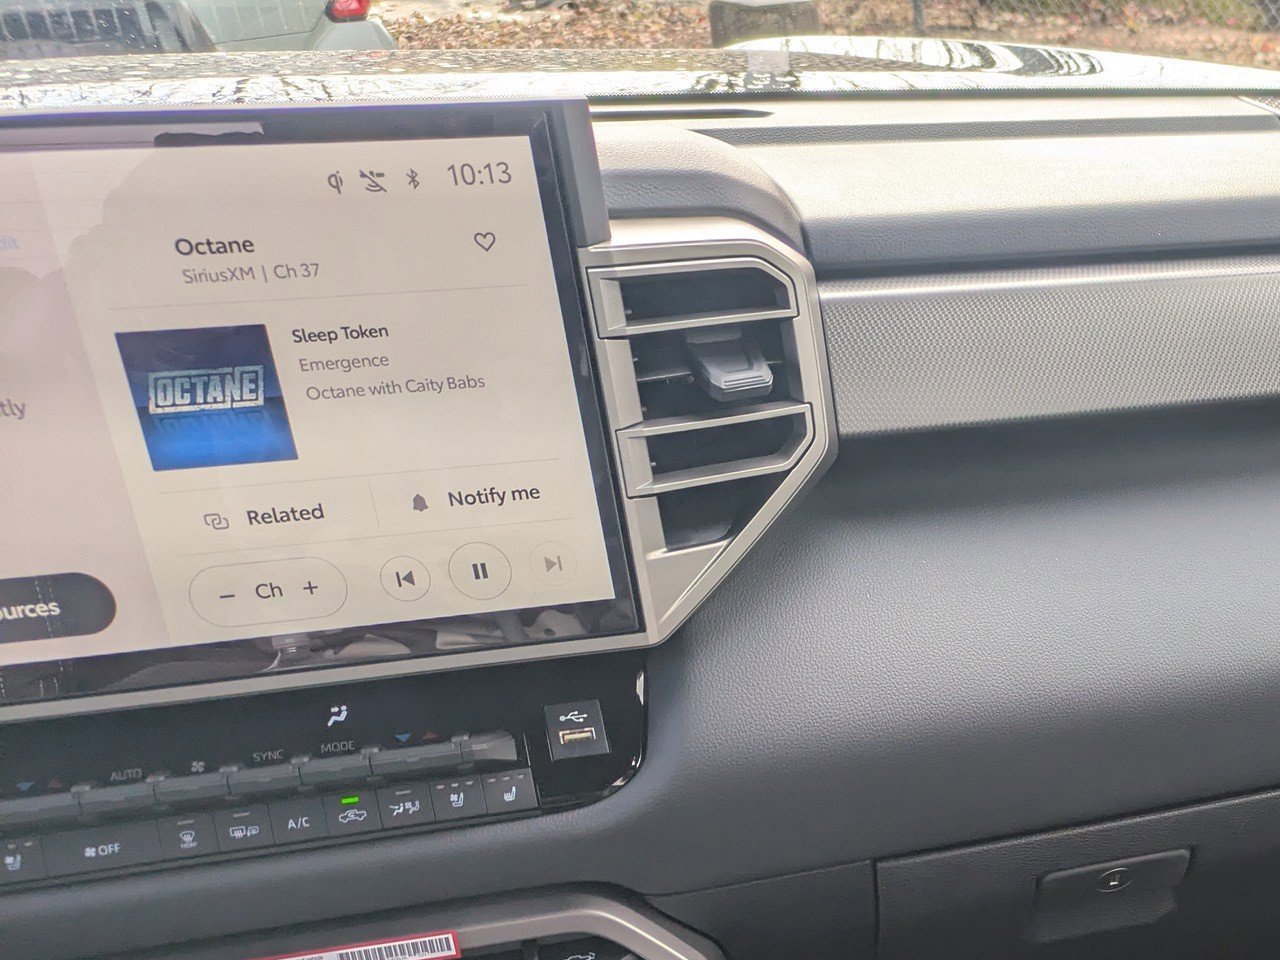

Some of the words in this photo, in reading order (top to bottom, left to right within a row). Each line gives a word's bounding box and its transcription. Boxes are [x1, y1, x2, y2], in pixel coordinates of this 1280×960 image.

[447, 162, 513, 187] 10:13
[175, 236, 255, 257] Octane
[183, 266, 256, 285] SiriusXM
[273, 263, 298, 280] Ch
[300, 262, 320, 279] 37
[292, 327, 336, 346] Sleep
[341, 323, 390, 341] Token
[299, 353, 390, 375] Emergence
[152, 371, 262, 411] OCTANE
[306, 383, 364, 402] Octane
[367, 379, 403, 396] with
[405, 376, 445, 396] Caity
[447, 374, 486, 391] Babs
[448, 487, 505, 510] Notify
[509, 486, 541, 502] me
[247, 504, 325, 527] Related
[256, 582, 283, 599] Ch
[253, 749, 284, 761] SYNC
[321, 740, 355, 754] MODE
[110, 768, 143, 781] AUTO
[288, 817, 309, 830] A/C
[98, 843, 121, 856] OFF
